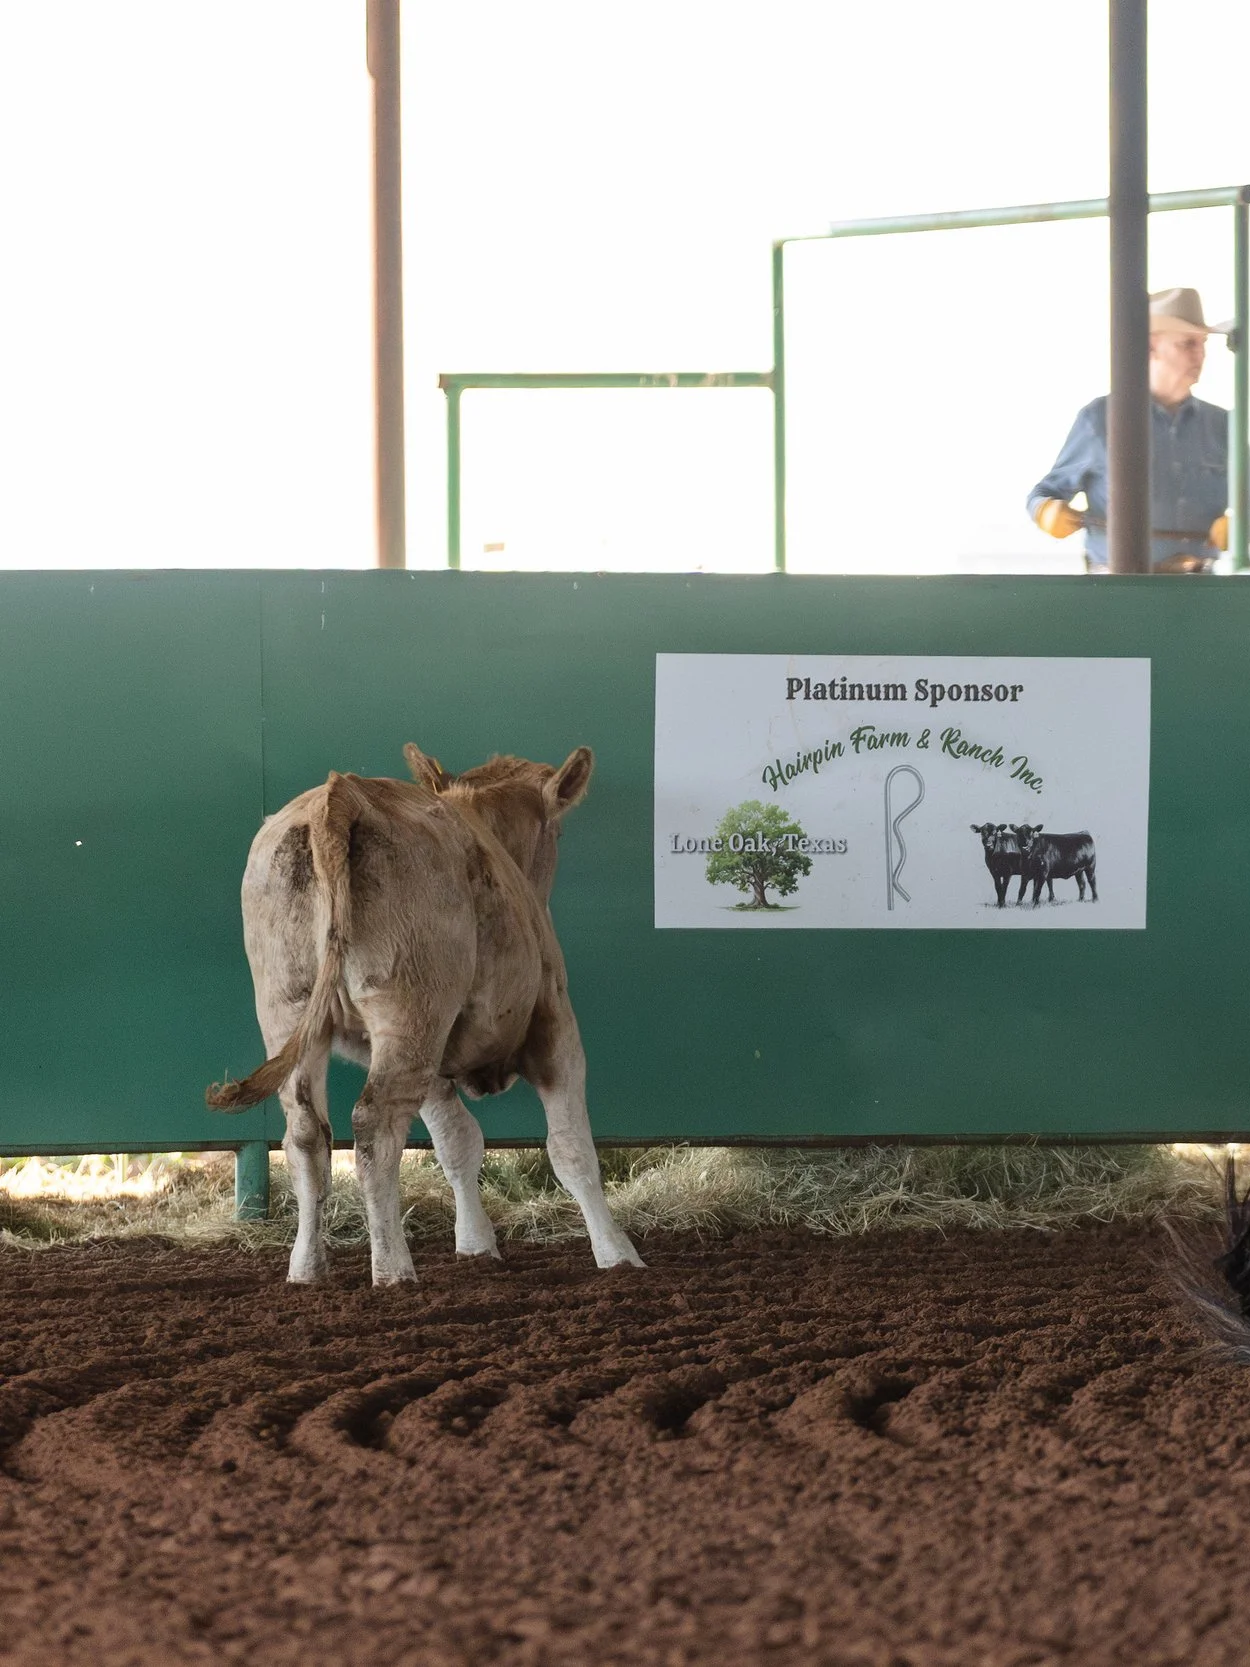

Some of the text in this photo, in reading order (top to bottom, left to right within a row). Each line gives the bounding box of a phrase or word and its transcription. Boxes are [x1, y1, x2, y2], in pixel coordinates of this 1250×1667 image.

[785, 675, 1024, 708] Platinum Sponsor
[762, 725, 1044, 795] Hairpin Farm & Ranch Inc.
[671, 833, 725, 855] Lone
[782, 833, 848, 855] Texas
